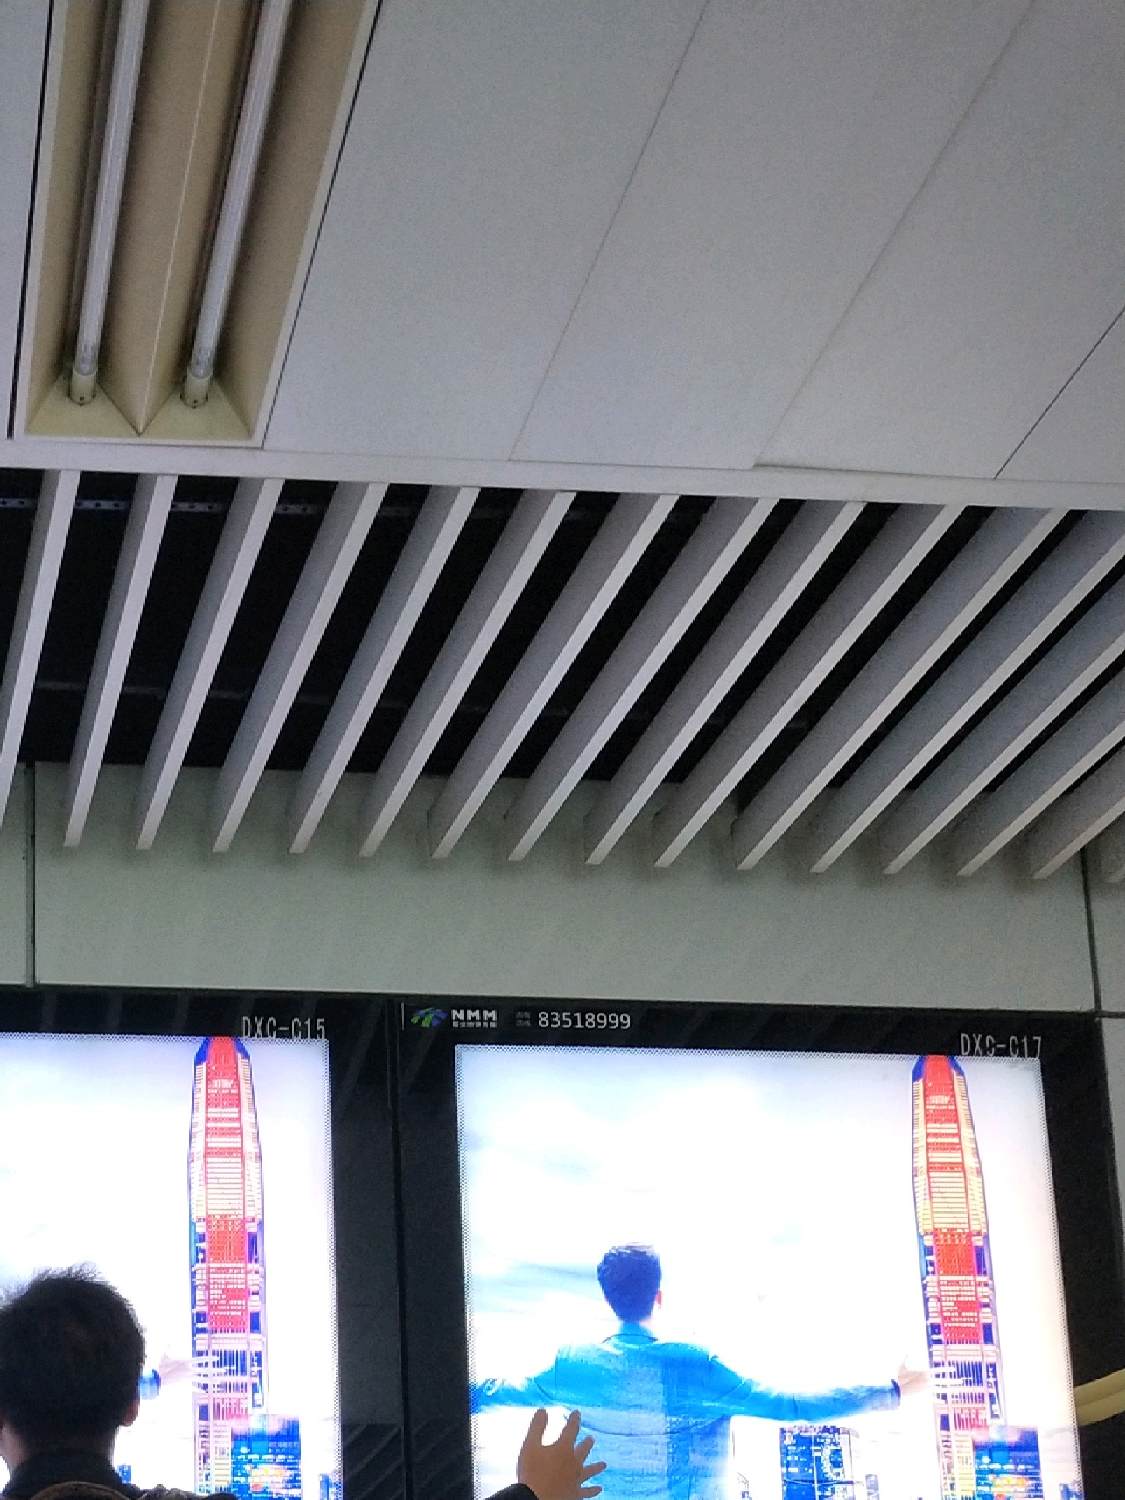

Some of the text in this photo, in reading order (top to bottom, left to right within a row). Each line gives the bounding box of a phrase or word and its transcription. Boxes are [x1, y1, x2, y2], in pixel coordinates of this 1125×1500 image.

[451, 1009, 498, 1021] NMM
[538, 1011, 631, 1029] 83518999
[242, 1016, 325, 1040] DXC-C15
[960, 1033, 1042, 1058] DXC-C17
